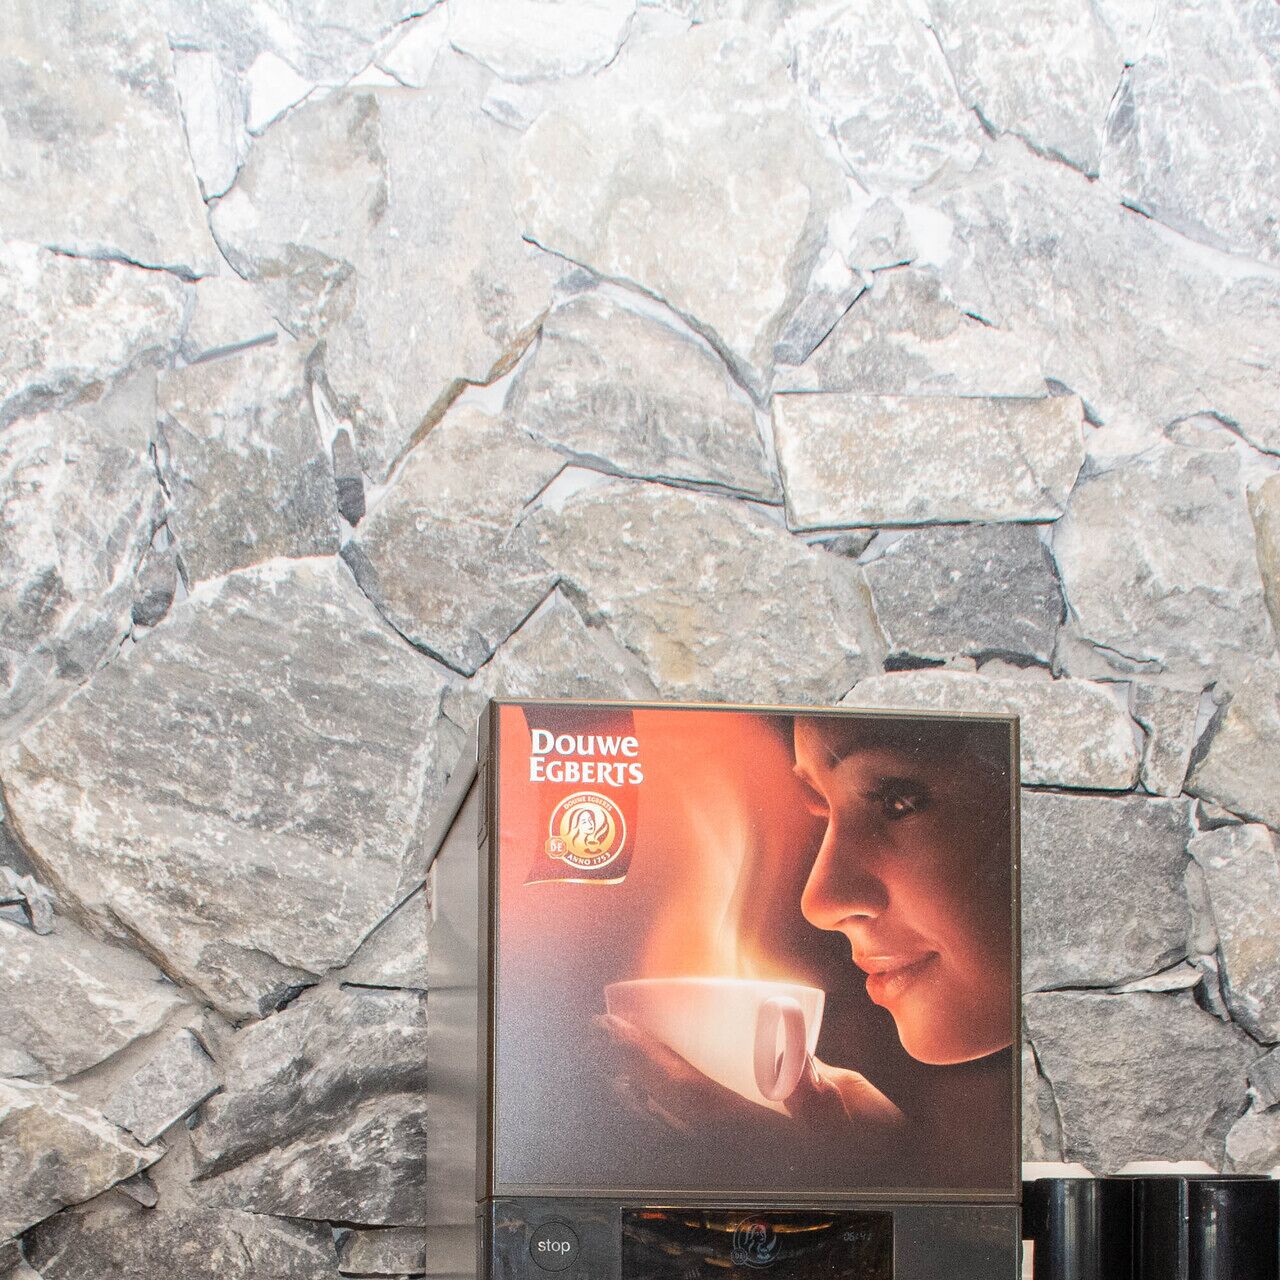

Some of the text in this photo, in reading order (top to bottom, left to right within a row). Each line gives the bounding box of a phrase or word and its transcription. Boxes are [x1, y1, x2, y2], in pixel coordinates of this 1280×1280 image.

[531, 728, 640, 757] Douwe
[529, 757, 644, 787] EGBERTS
[563, 796, 613, 812] DOUWE EGBERTS
[566, 852, 612, 865] ANNO 1753
[537, 1238, 571, 1256] stop
